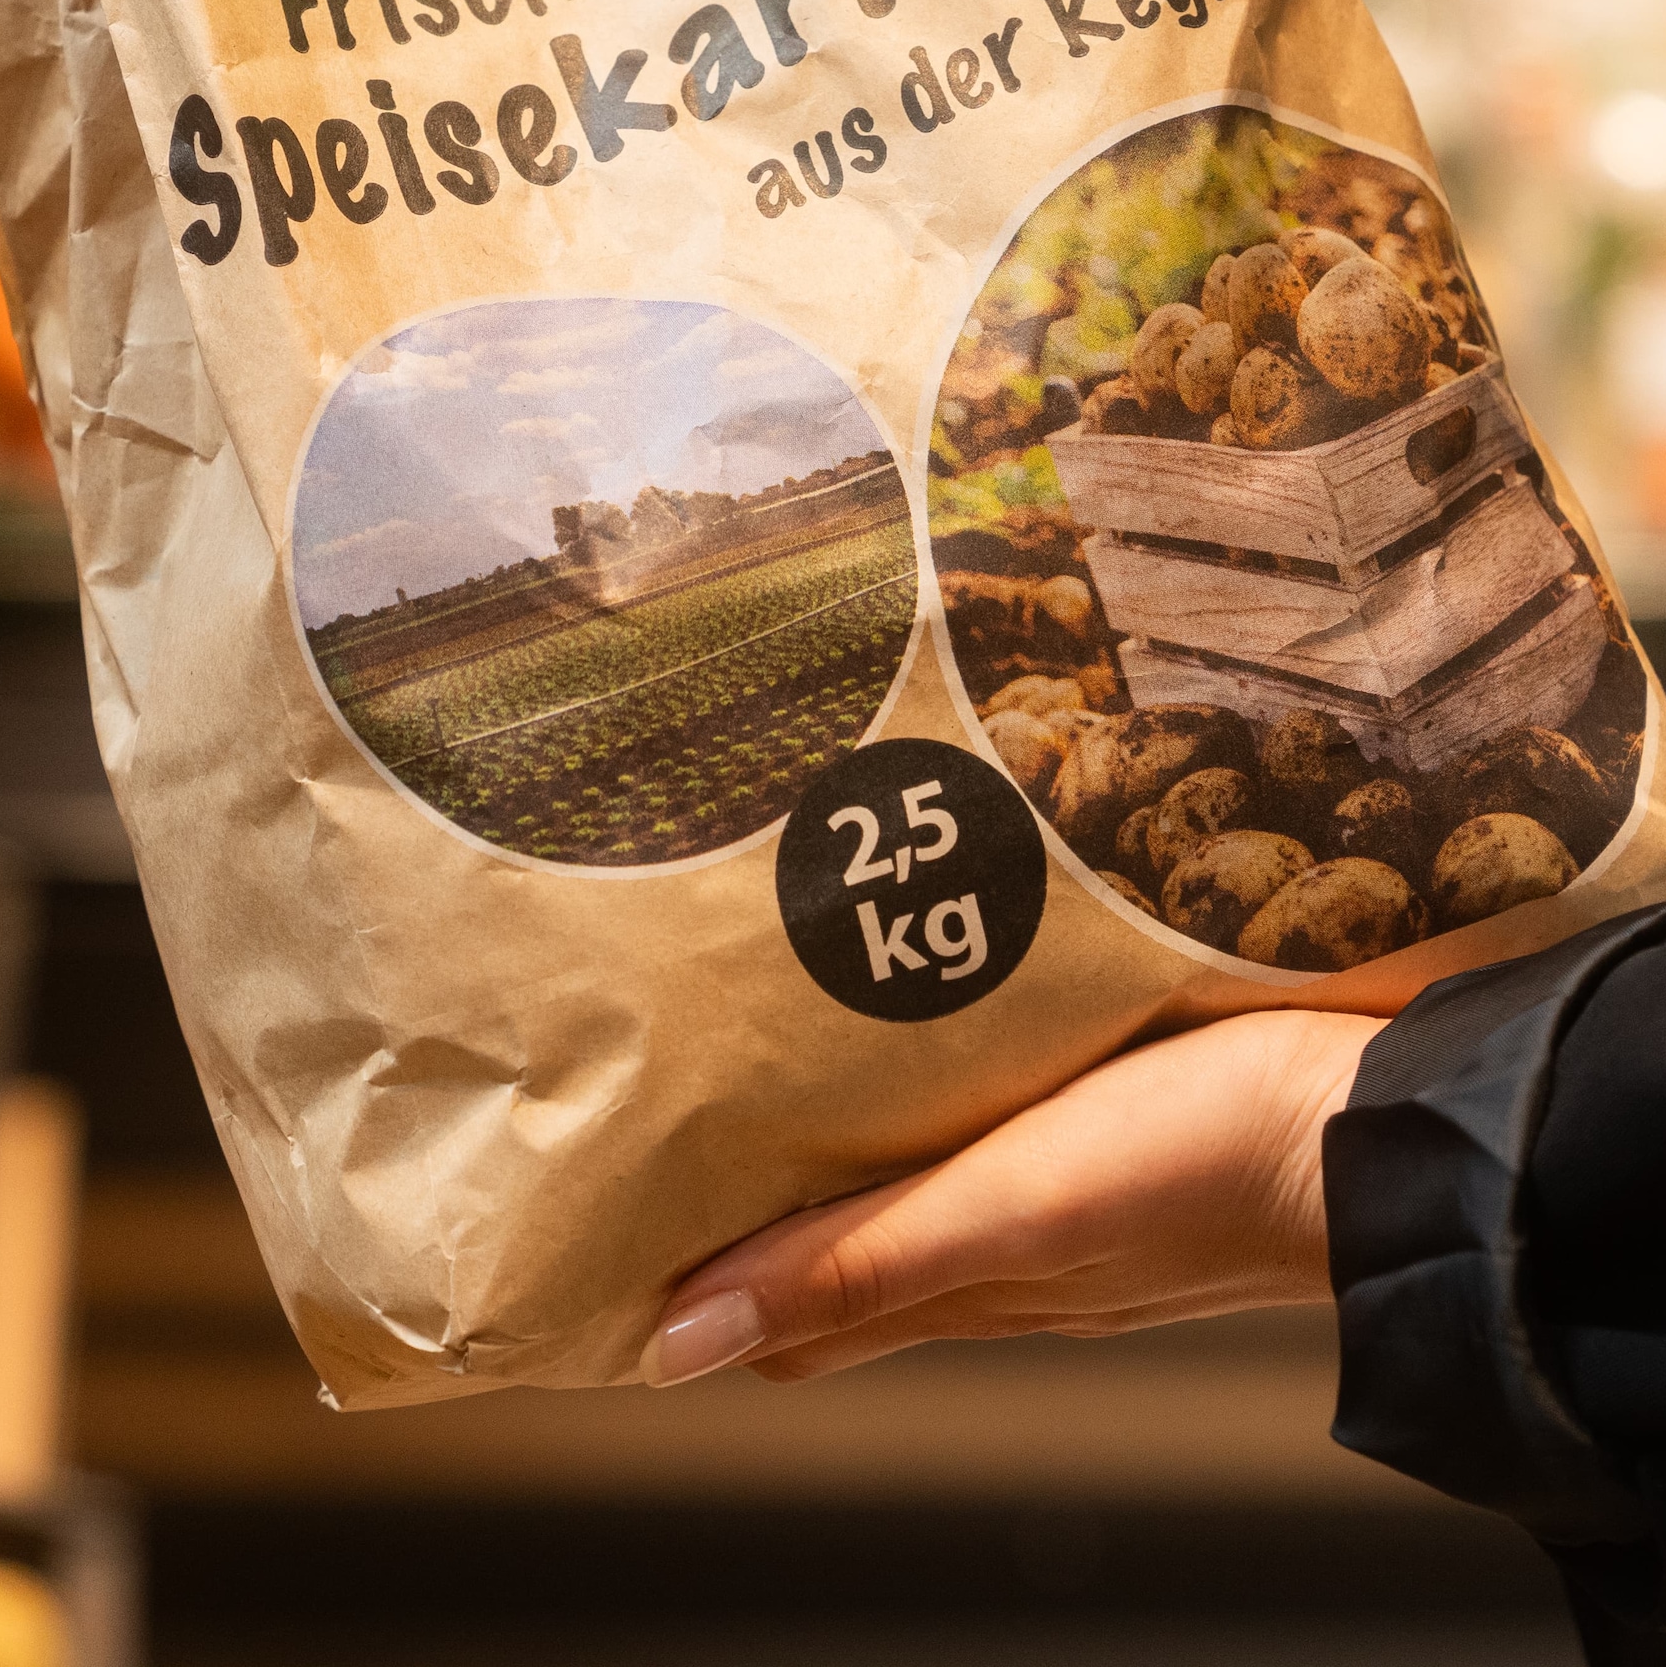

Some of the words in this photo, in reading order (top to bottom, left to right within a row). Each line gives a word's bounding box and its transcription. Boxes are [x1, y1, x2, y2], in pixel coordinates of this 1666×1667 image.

[746, 104, 889, 219] aus
[900, 16, 1023, 132] der
[826, 779, 959, 888] 2,5
[855, 892, 989, 983] kg
